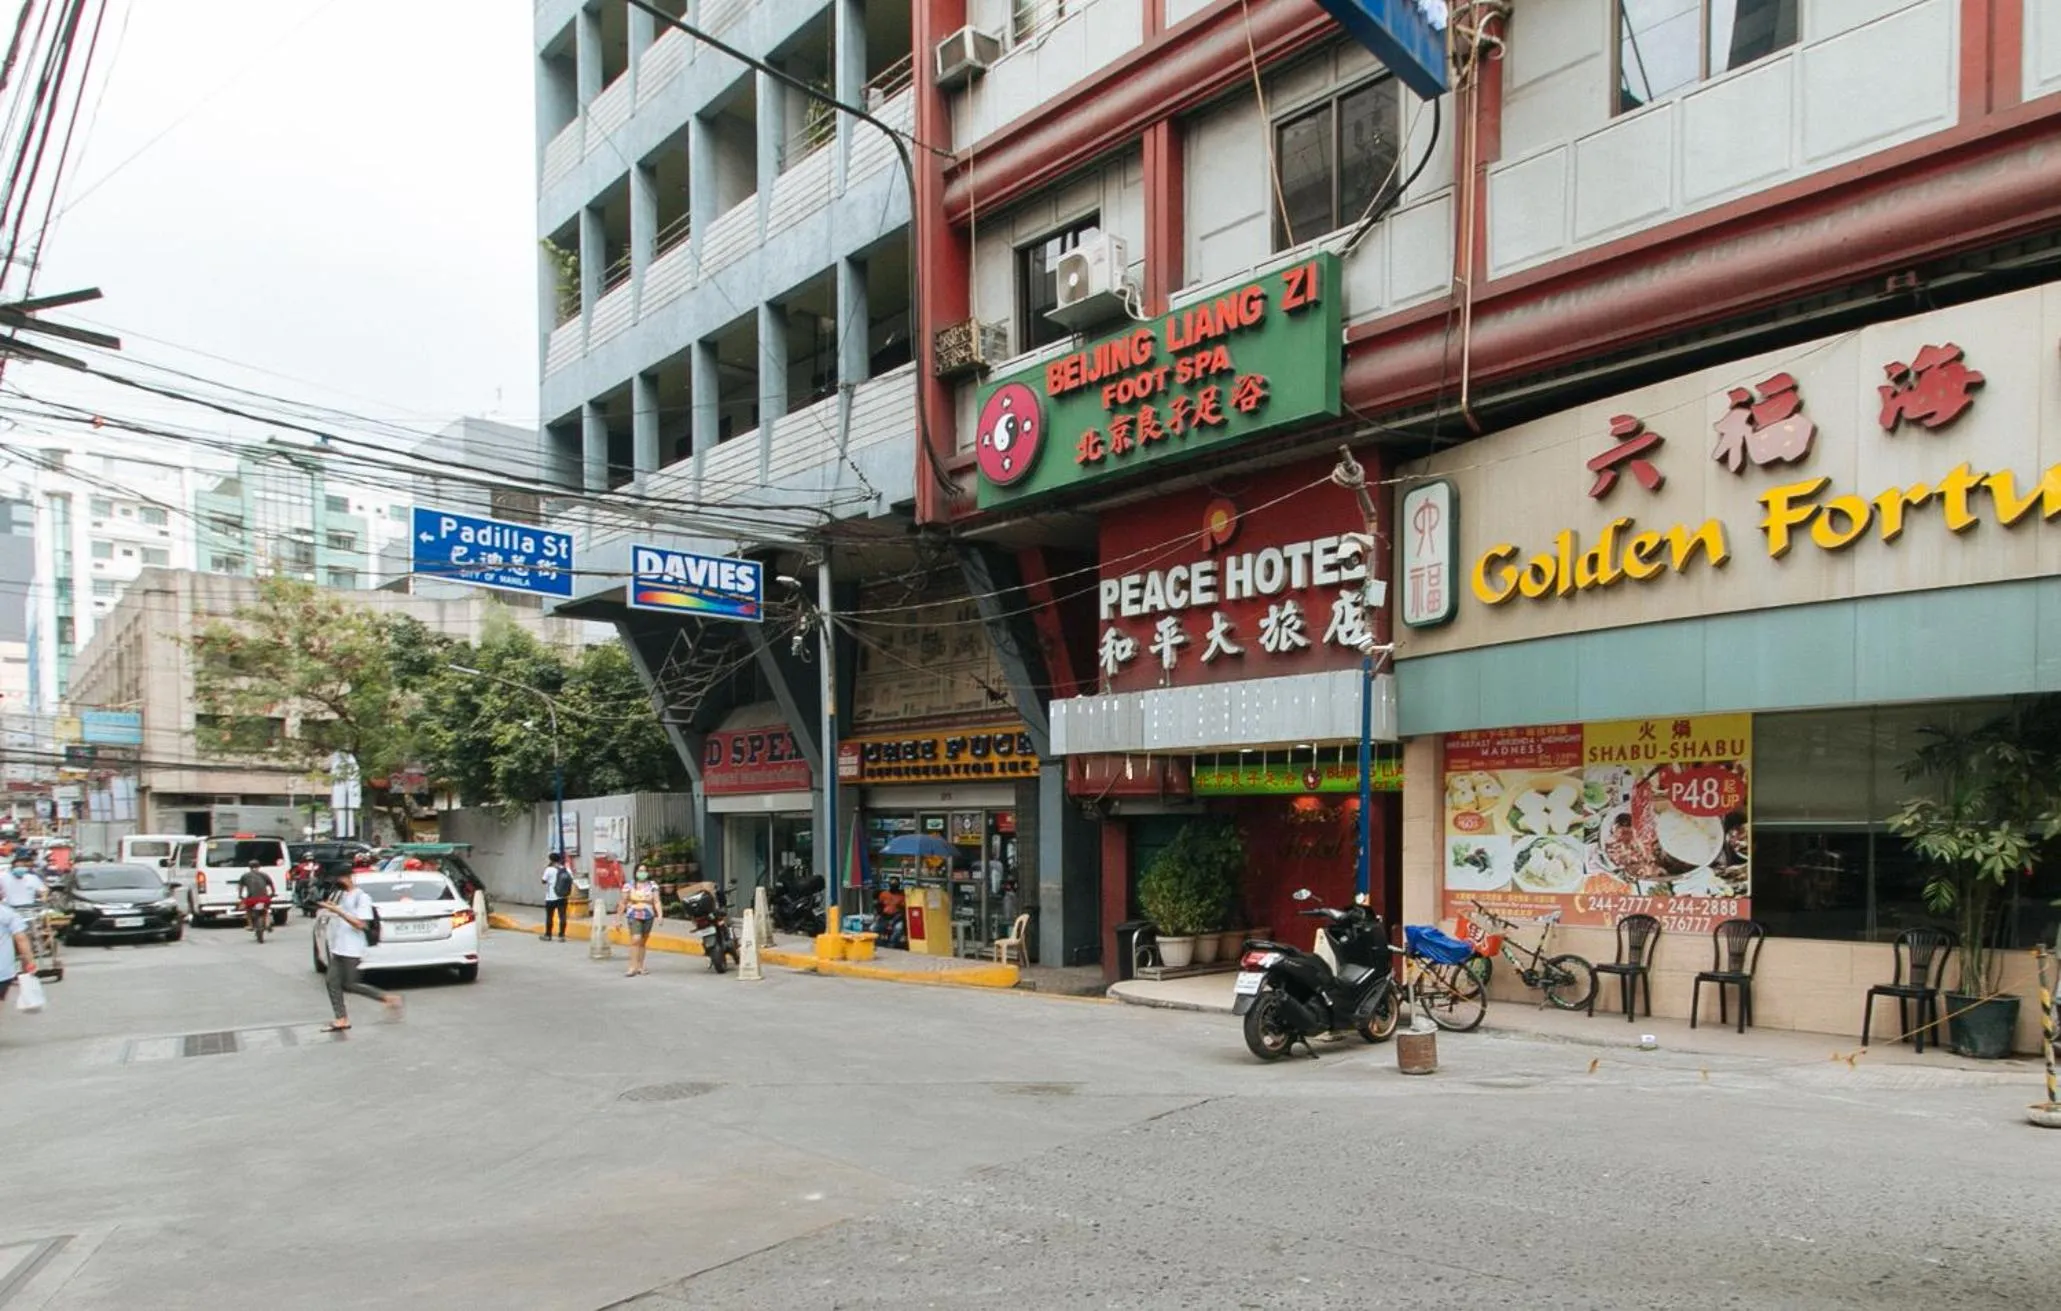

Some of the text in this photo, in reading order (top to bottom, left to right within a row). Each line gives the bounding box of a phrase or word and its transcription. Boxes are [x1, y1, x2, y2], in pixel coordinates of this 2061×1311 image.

[1045, 260, 1320, 397] BEIJING LIANG ZI
[1102, 345, 1236, 410] FOOT SPA
[1075, 373, 1270, 464] 北京良子足浴
[440, 516, 569, 560] Padilla St
[1471, 514, 1730, 606] Golden
[484, 573, 496, 582] OF
[499, 575, 531, 587] MANILA
[637, 549, 756, 593] DAVIES
[1100, 560, 1220, 621] PEACE
[1099, 588, 1365, 677] 和平大旅店
[1481, 745, 1545, 757] MADNESS
[1588, 739, 1745, 762] SHABU-SHABU
[1671, 776, 1719, 809] P48
[1720, 794, 1740, 809] UP
[1588, 895, 1739, 916] 244-2777 244-2888
